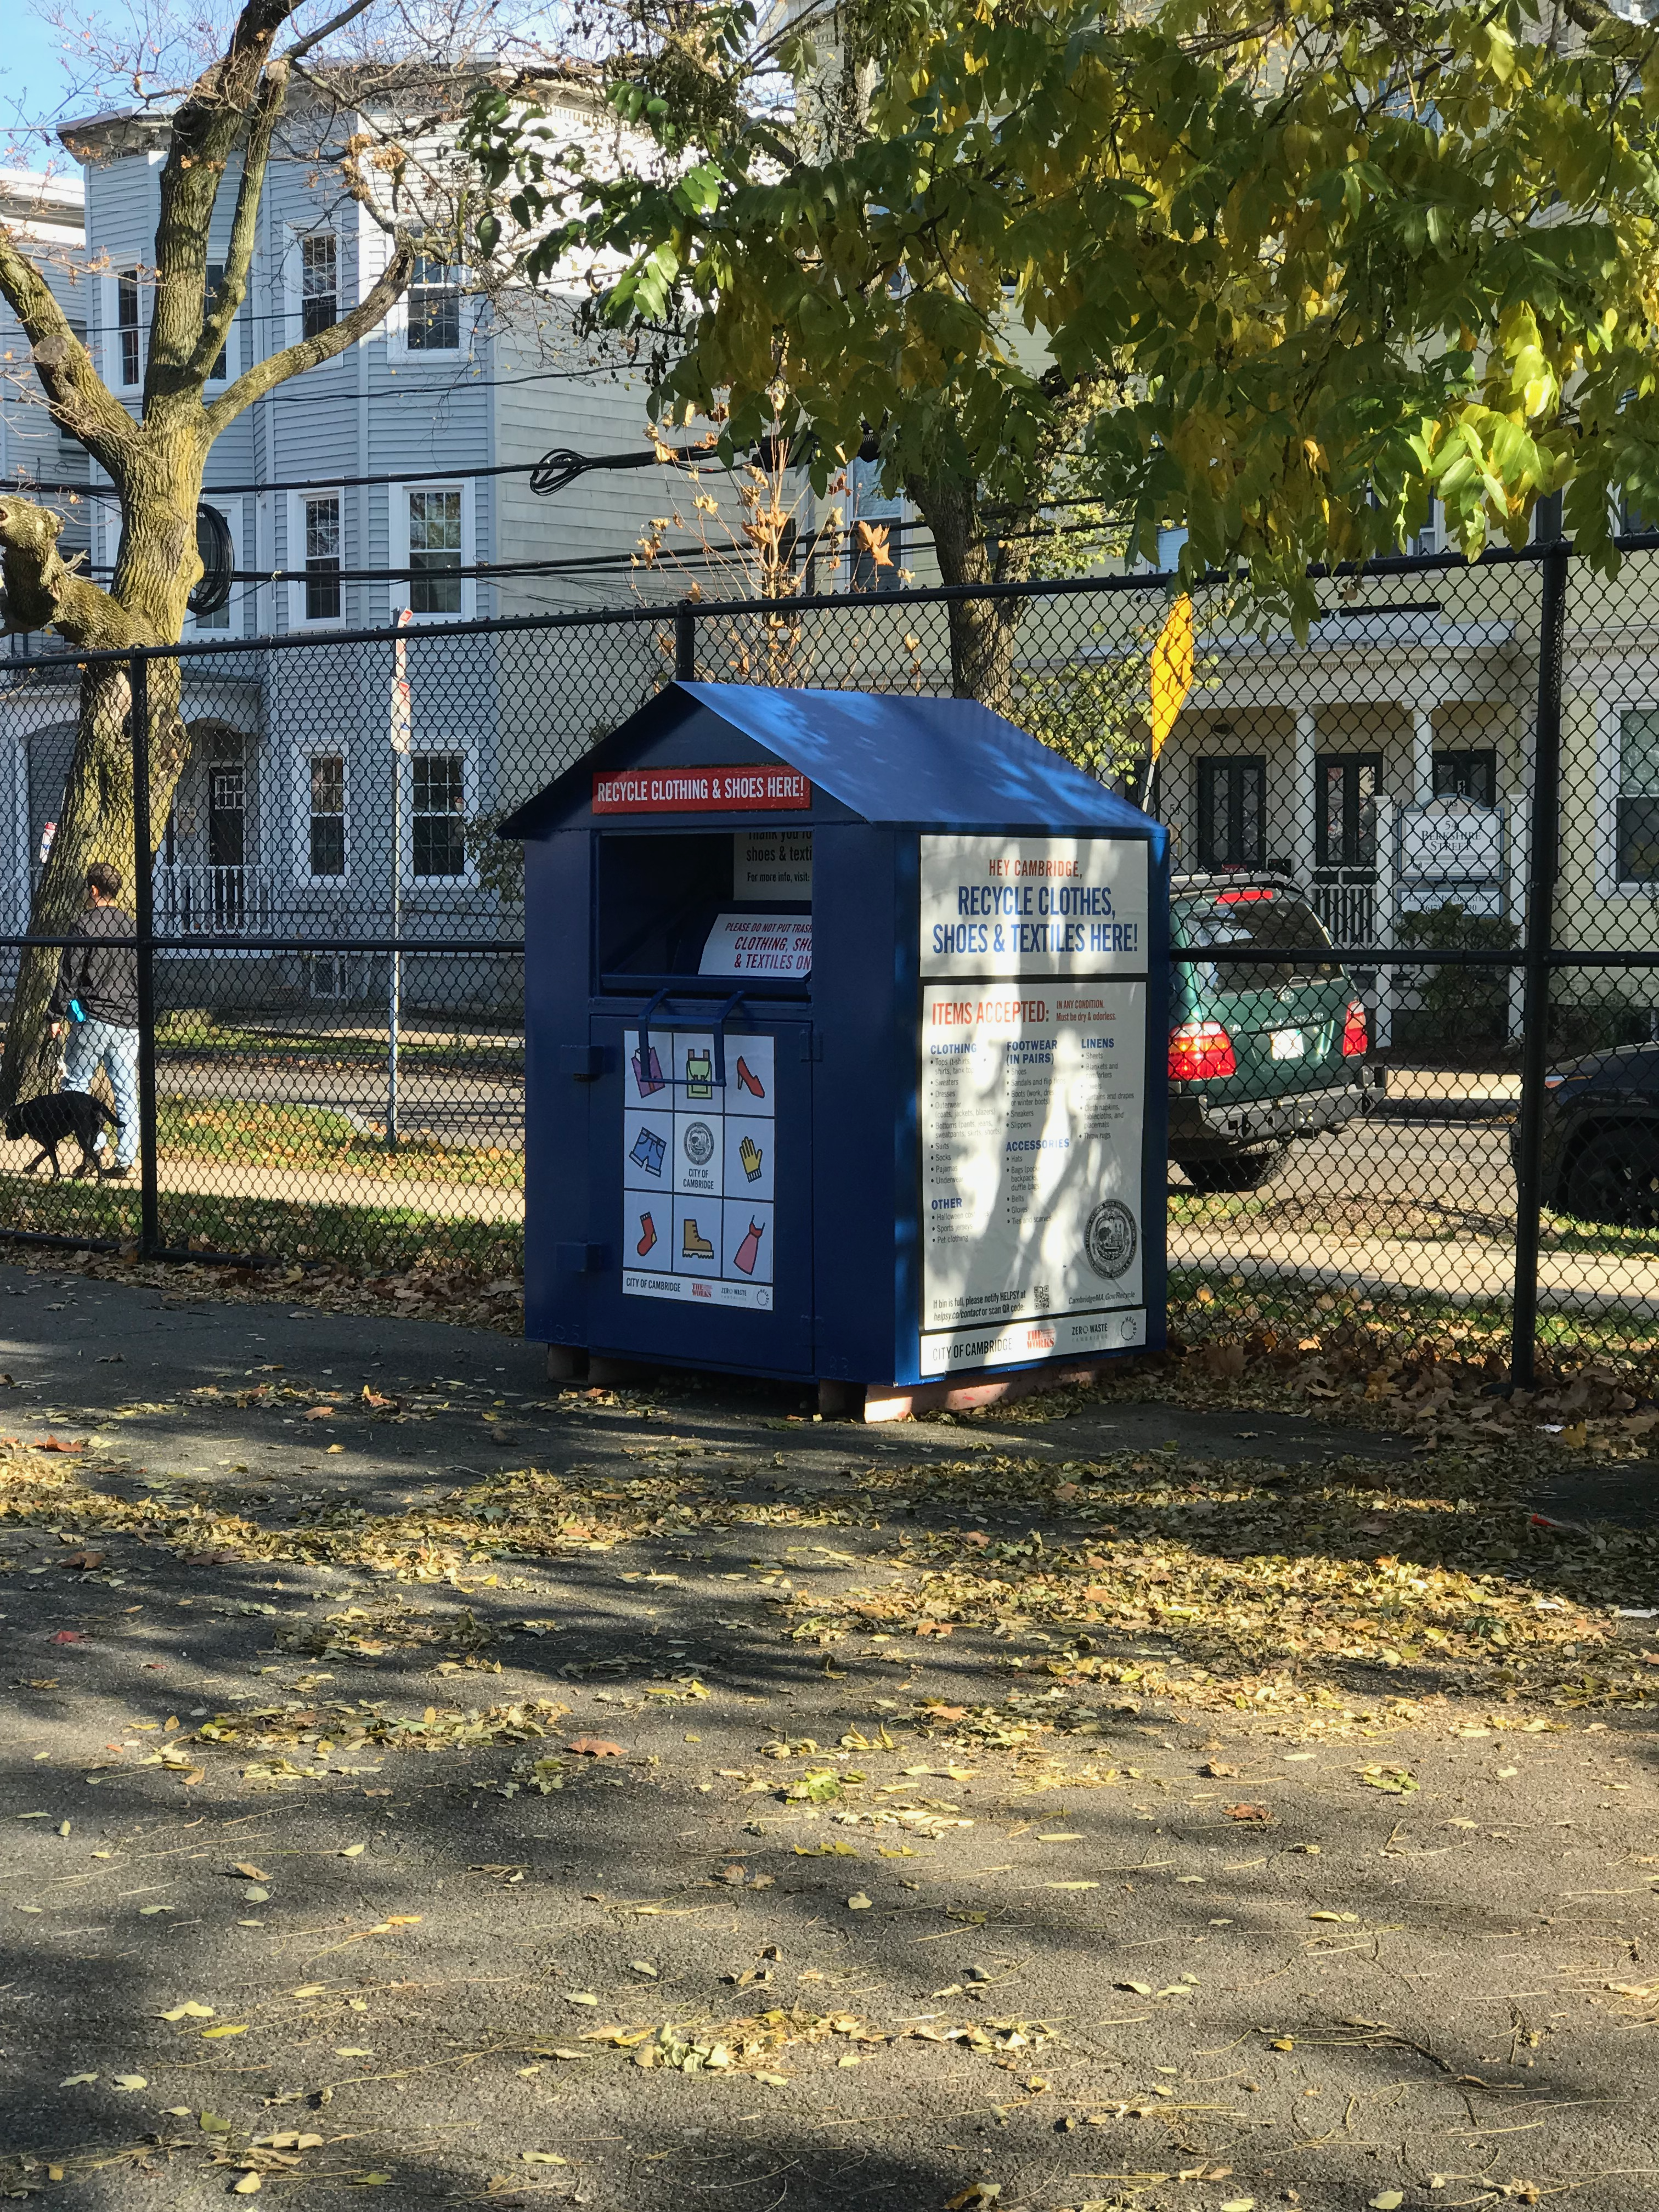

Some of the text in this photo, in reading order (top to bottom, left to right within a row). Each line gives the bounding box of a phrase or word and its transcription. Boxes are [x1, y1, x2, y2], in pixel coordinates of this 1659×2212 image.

[597, 776, 804, 802] RECYCLE CLOTHING & SHOES HERE!
[1444, 820, 1457, 830] 54
[1421, 831, 1481, 840] BERKSHIRE
[1430, 840, 1469, 851] STREET
[746, 846, 775, 862] shoes
[779, 846, 786, 861] &
[989, 859, 1083, 879] HEY CAMBRIDGE,
[747, 871, 810, 883] For more info, visit:
[958, 885, 1116, 920] RECYCLE CLOTHES,
[725, 922, 751, 932] PLEASE
[751, 923, 761, 932] DO
[763, 923, 777, 933] NOT
[777, 923, 792, 933] PUT
[932, 923, 1138, 953] SHOES & TEXTILES HERE!
[734, 936, 788, 953] CLOTHING,
[734, 953, 742, 968] &
[746, 953, 793, 970] TEXTILES
[1057, 999, 1105, 1009] IN ANY CONDITION.
[932, 1001, 1049, 1025] ITEMS ACCEPTED:
[1056, 1011, 1117, 1023] Must be dry & odorless.
[930, 1043, 977, 1054] CLOTHING
[1007, 1040, 1057, 1052] FOOTWEAR
[1081, 1038, 1115, 1049] LINENS
[935, 1058, 947, 1066] Tops
[1006, 1053, 1054, 1066] (IN PAIRS)
[935, 1079, 959, 1087] Sweaters
[1011, 1078, 1031, 1086] Sandals
[1118, 1092, 1135, 1101] drapes
[1011, 1110, 1034, 1118] Sneakers
[1011, 1122, 1032, 1130] Slippers
[1099, 1132, 1111, 1141] rugs
[935, 1142, 950, 1150] Suits
[1006, 1138, 1070, 1152] ACCESSORIES
[935, 1154, 951, 1162] Socks
[689, 1168, 709, 1178] CITY OF
[936, 1165, 958, 1175] Pajamas
[1011, 1166, 1024, 1175] Bags
[683, 1178, 714, 1190] CAMBRIDGE
[936, 1176, 964, 1184] Underwear
[932, 1198, 962, 1210] OTHER
[936, 1212, 964, 1221] Halloween
[937, 1224, 954, 1233] Sports
[937, 1234, 969, 1244] Pet clothing
[626, 1277, 681, 1293] CITY OF CAMBRIDGE
[692, 1289, 713, 1299] WORKS
[933, 1290, 1026, 1309] If bin is full, please notify HELPSY at
[933, 1307, 981, 1322] helpsy.co/contact
[989, 1306, 1001, 1315] scan
[1002, 1304, 1010, 1313] QR
[1011, 1303, 1025, 1312] code:
[1027, 1329, 1040, 1340] THE
[1071, 1323, 1108, 1336] ZERO WASTE
[933, 1338, 1012, 1361] CITY OF CAMBRIDGE
[1027, 1338, 1054, 1350] WORKS
